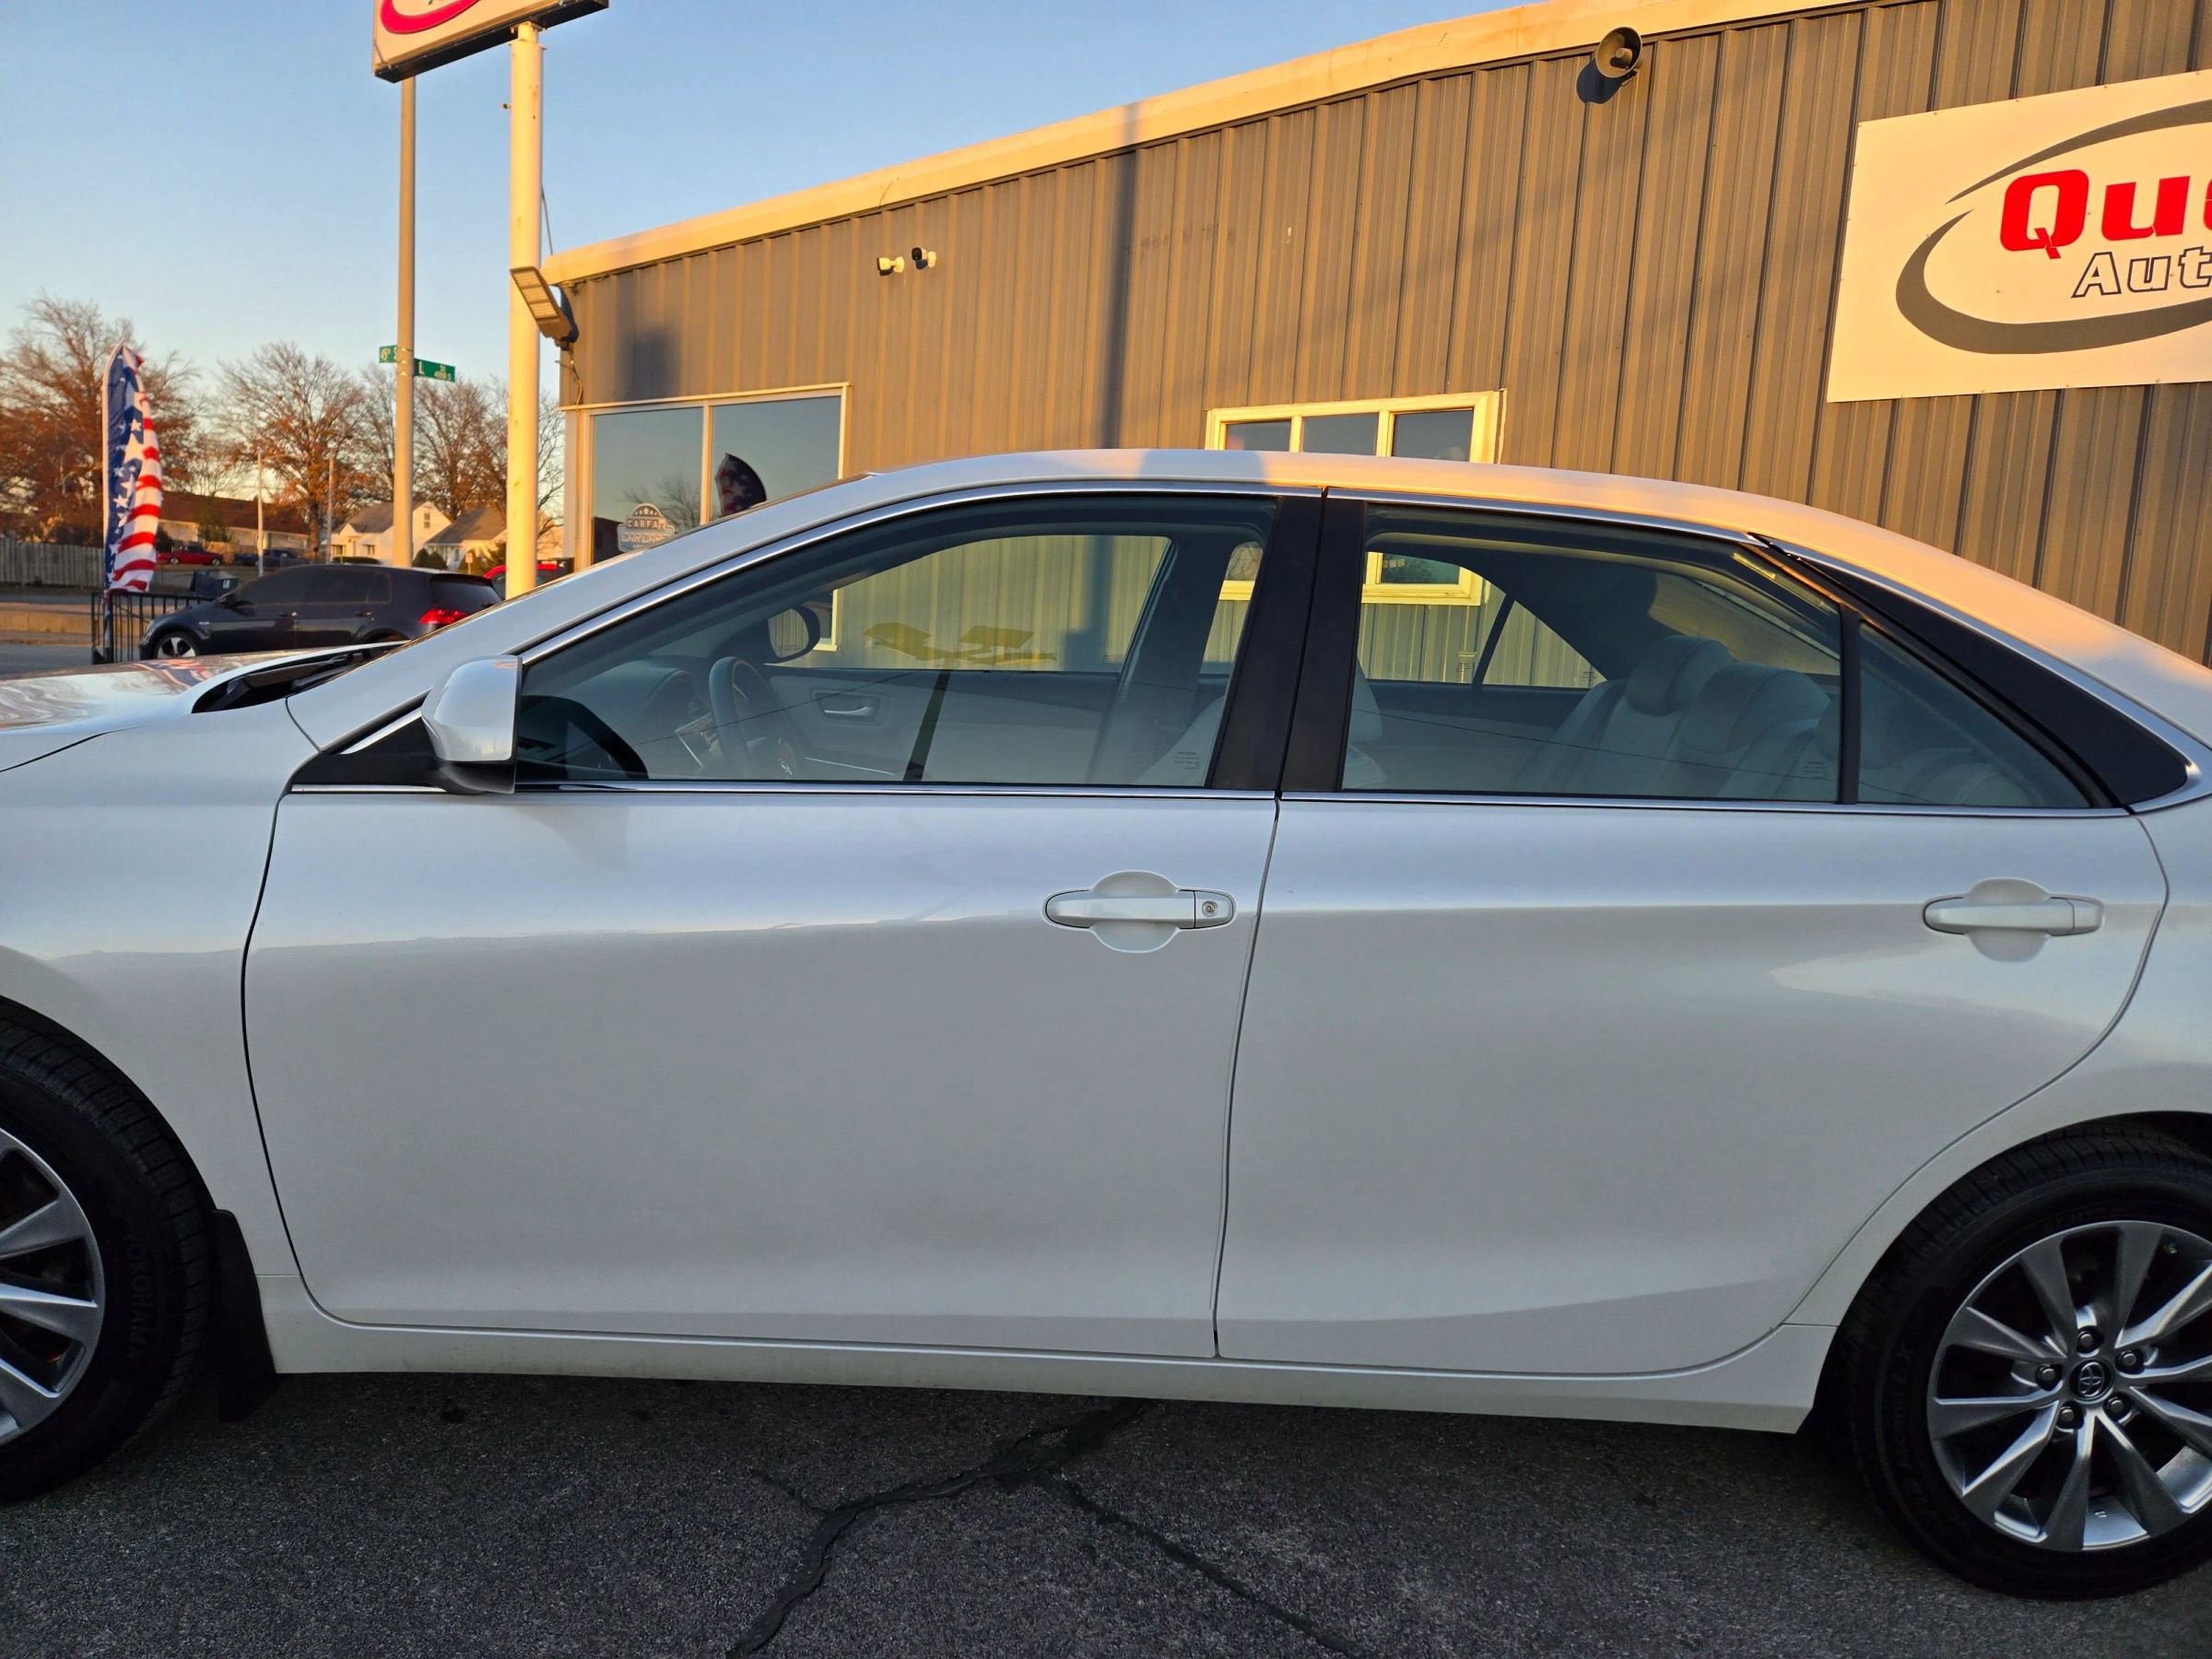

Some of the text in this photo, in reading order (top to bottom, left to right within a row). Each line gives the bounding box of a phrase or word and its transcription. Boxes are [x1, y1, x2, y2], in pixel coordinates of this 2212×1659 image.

[2000, 170, 2212, 259] Qu
[2071, 246, 2212, 298] Aut
[627, 519, 666, 530] CARFAX
